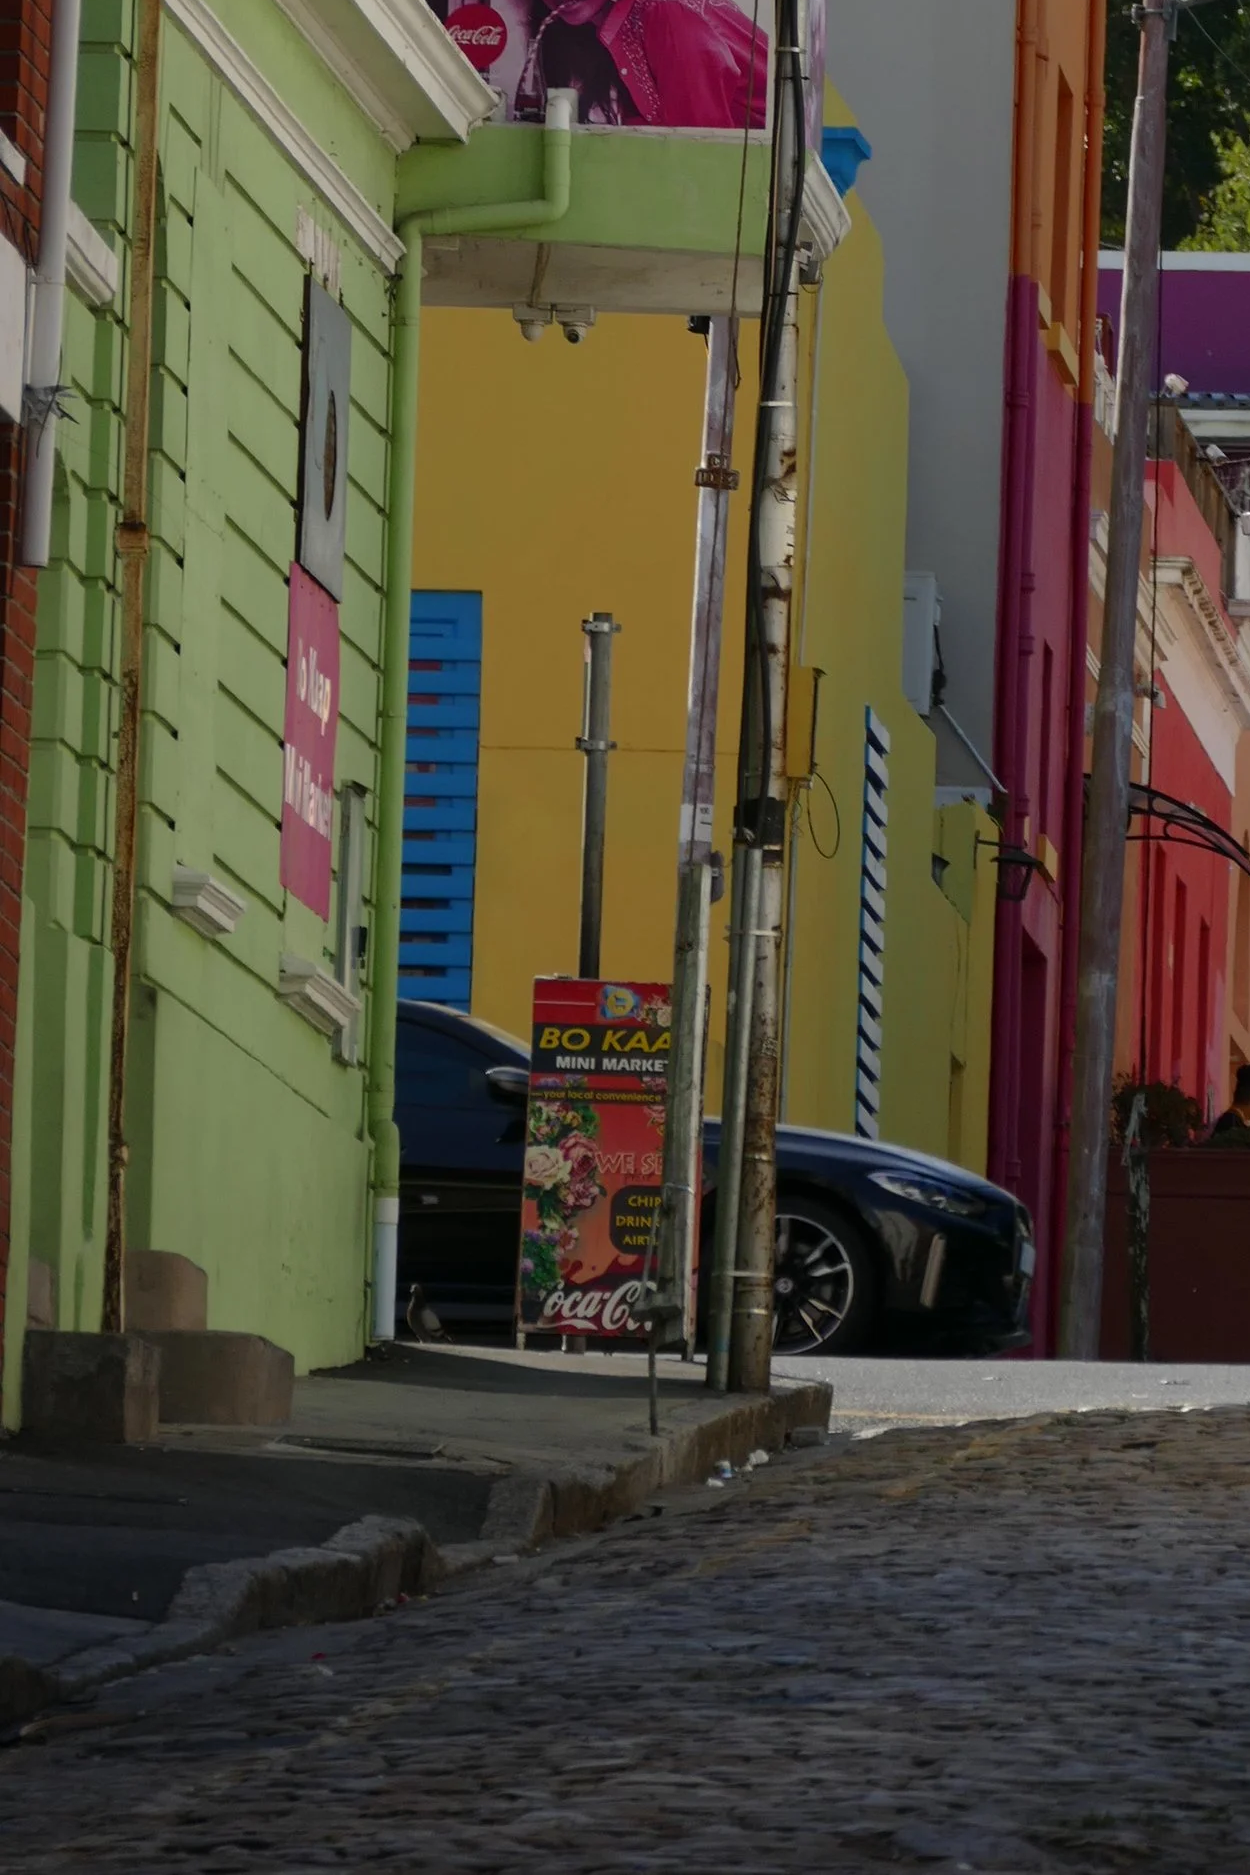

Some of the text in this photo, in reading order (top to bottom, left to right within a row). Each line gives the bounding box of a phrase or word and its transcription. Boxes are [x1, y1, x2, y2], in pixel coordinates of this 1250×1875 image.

[539, 1027, 671, 1053] BO KAA
[555, 1055, 669, 1073] MINI MARKE
[567, 1089, 594, 1100] local
[595, 1091, 662, 1103] convenience
[594, 1151, 634, 1174] WE
[628, 1195, 662, 1208] CHIP
